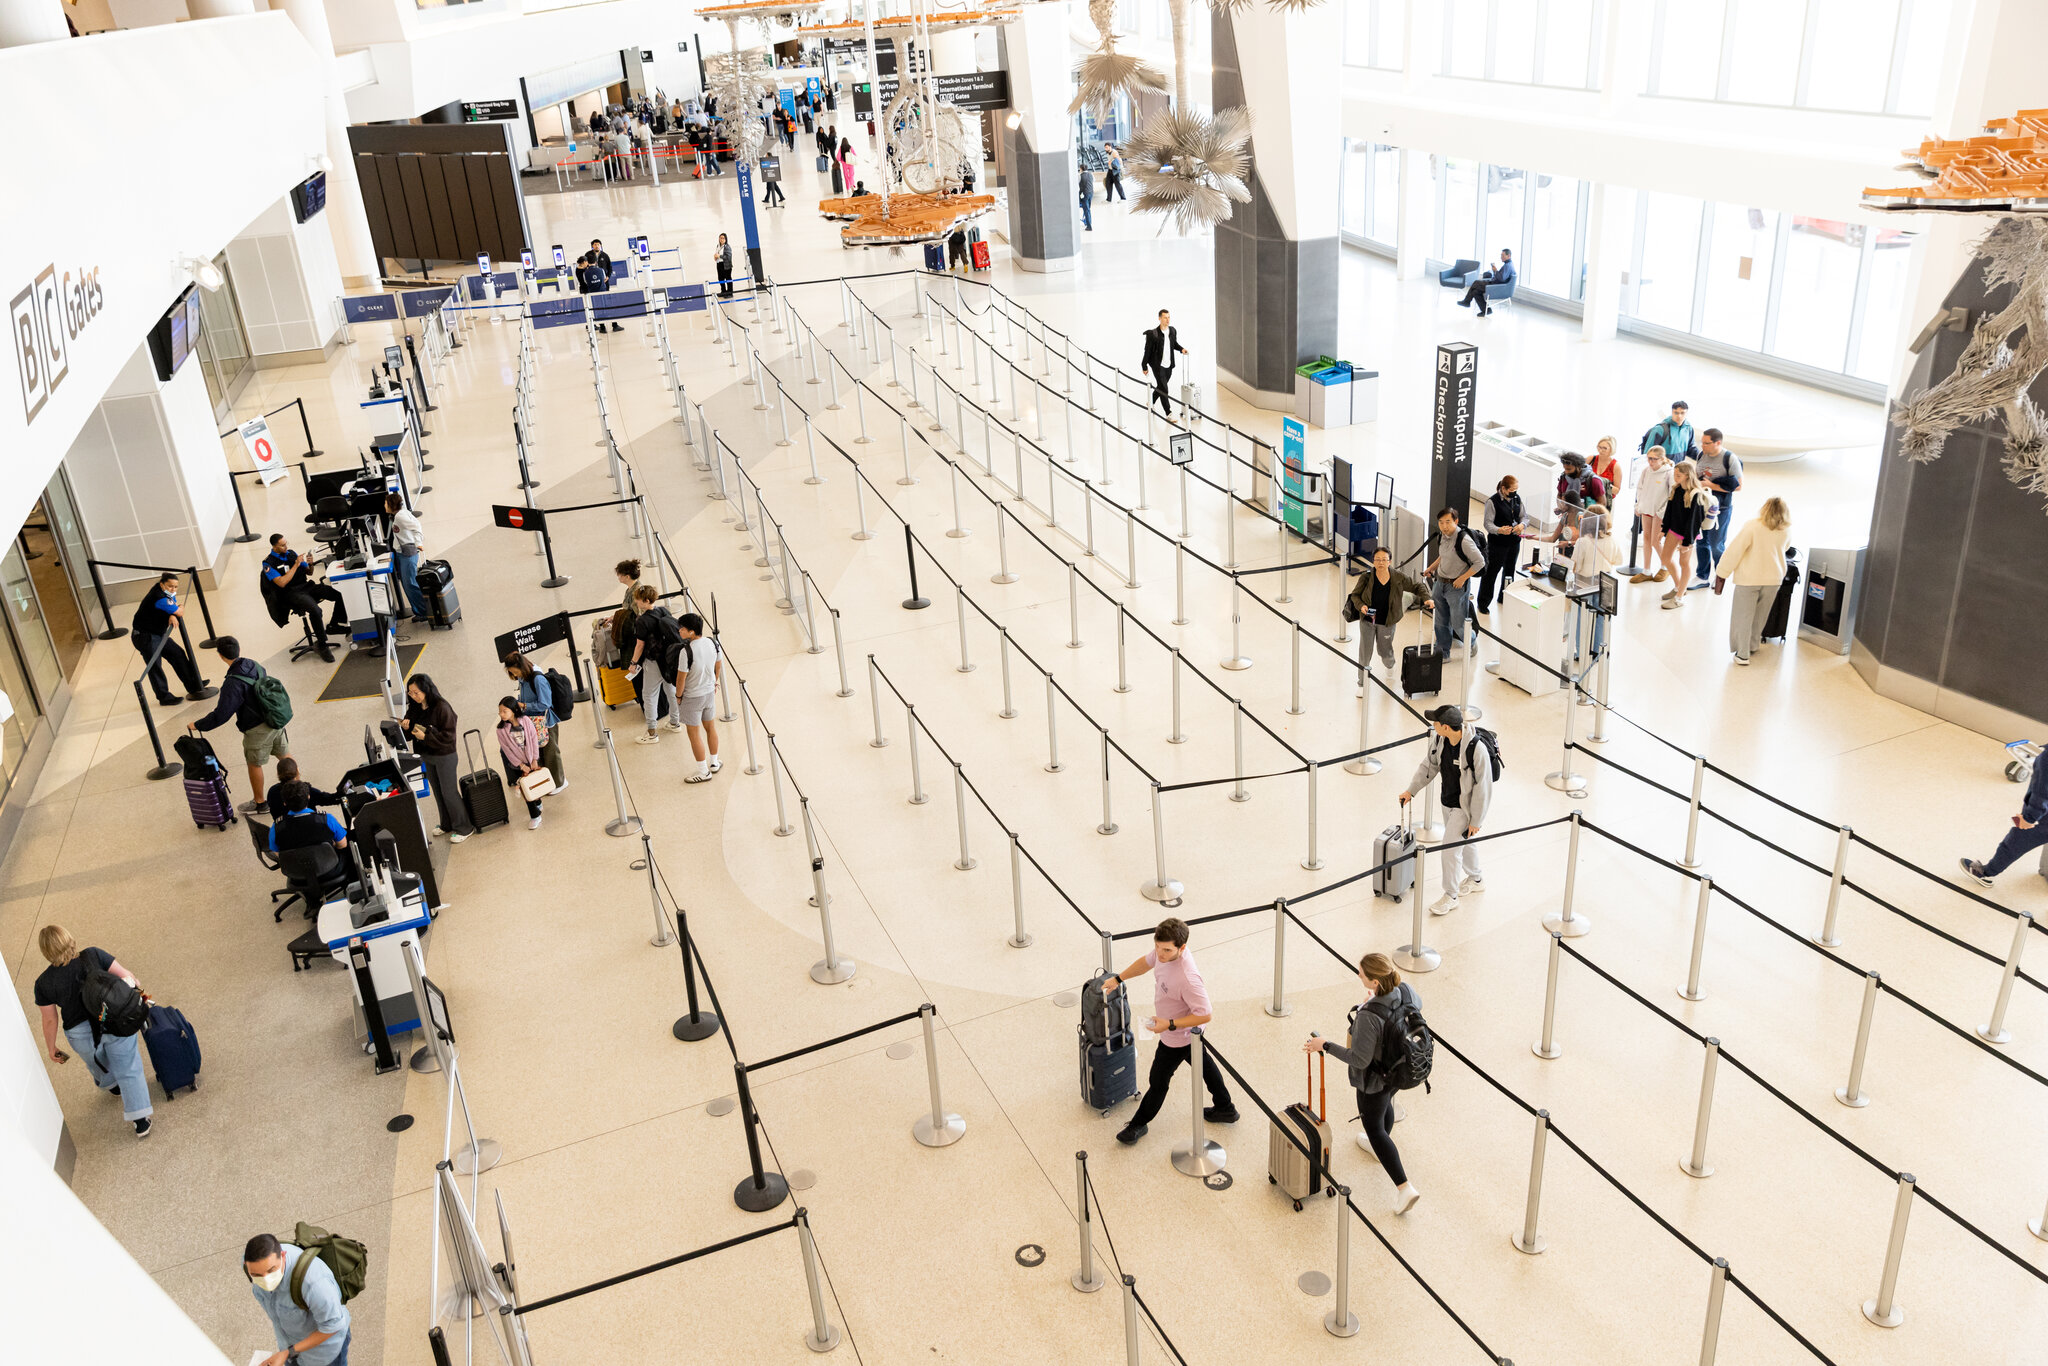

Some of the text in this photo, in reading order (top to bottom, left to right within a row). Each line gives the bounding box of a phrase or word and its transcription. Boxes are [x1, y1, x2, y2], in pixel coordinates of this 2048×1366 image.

[939, 77, 961, 85] Check-in
[940, 82, 994, 93] International Terminal
[63, 265, 103, 341] Gates
[1435, 376, 1449, 461] Checkpoint
[1453, 377, 1472, 463] Checkpoint
[1286, 425, 1297, 435] Have
[514, 624, 541, 639] Please
[515, 634, 535, 646] Wait
[517, 642, 537, 654] Here
